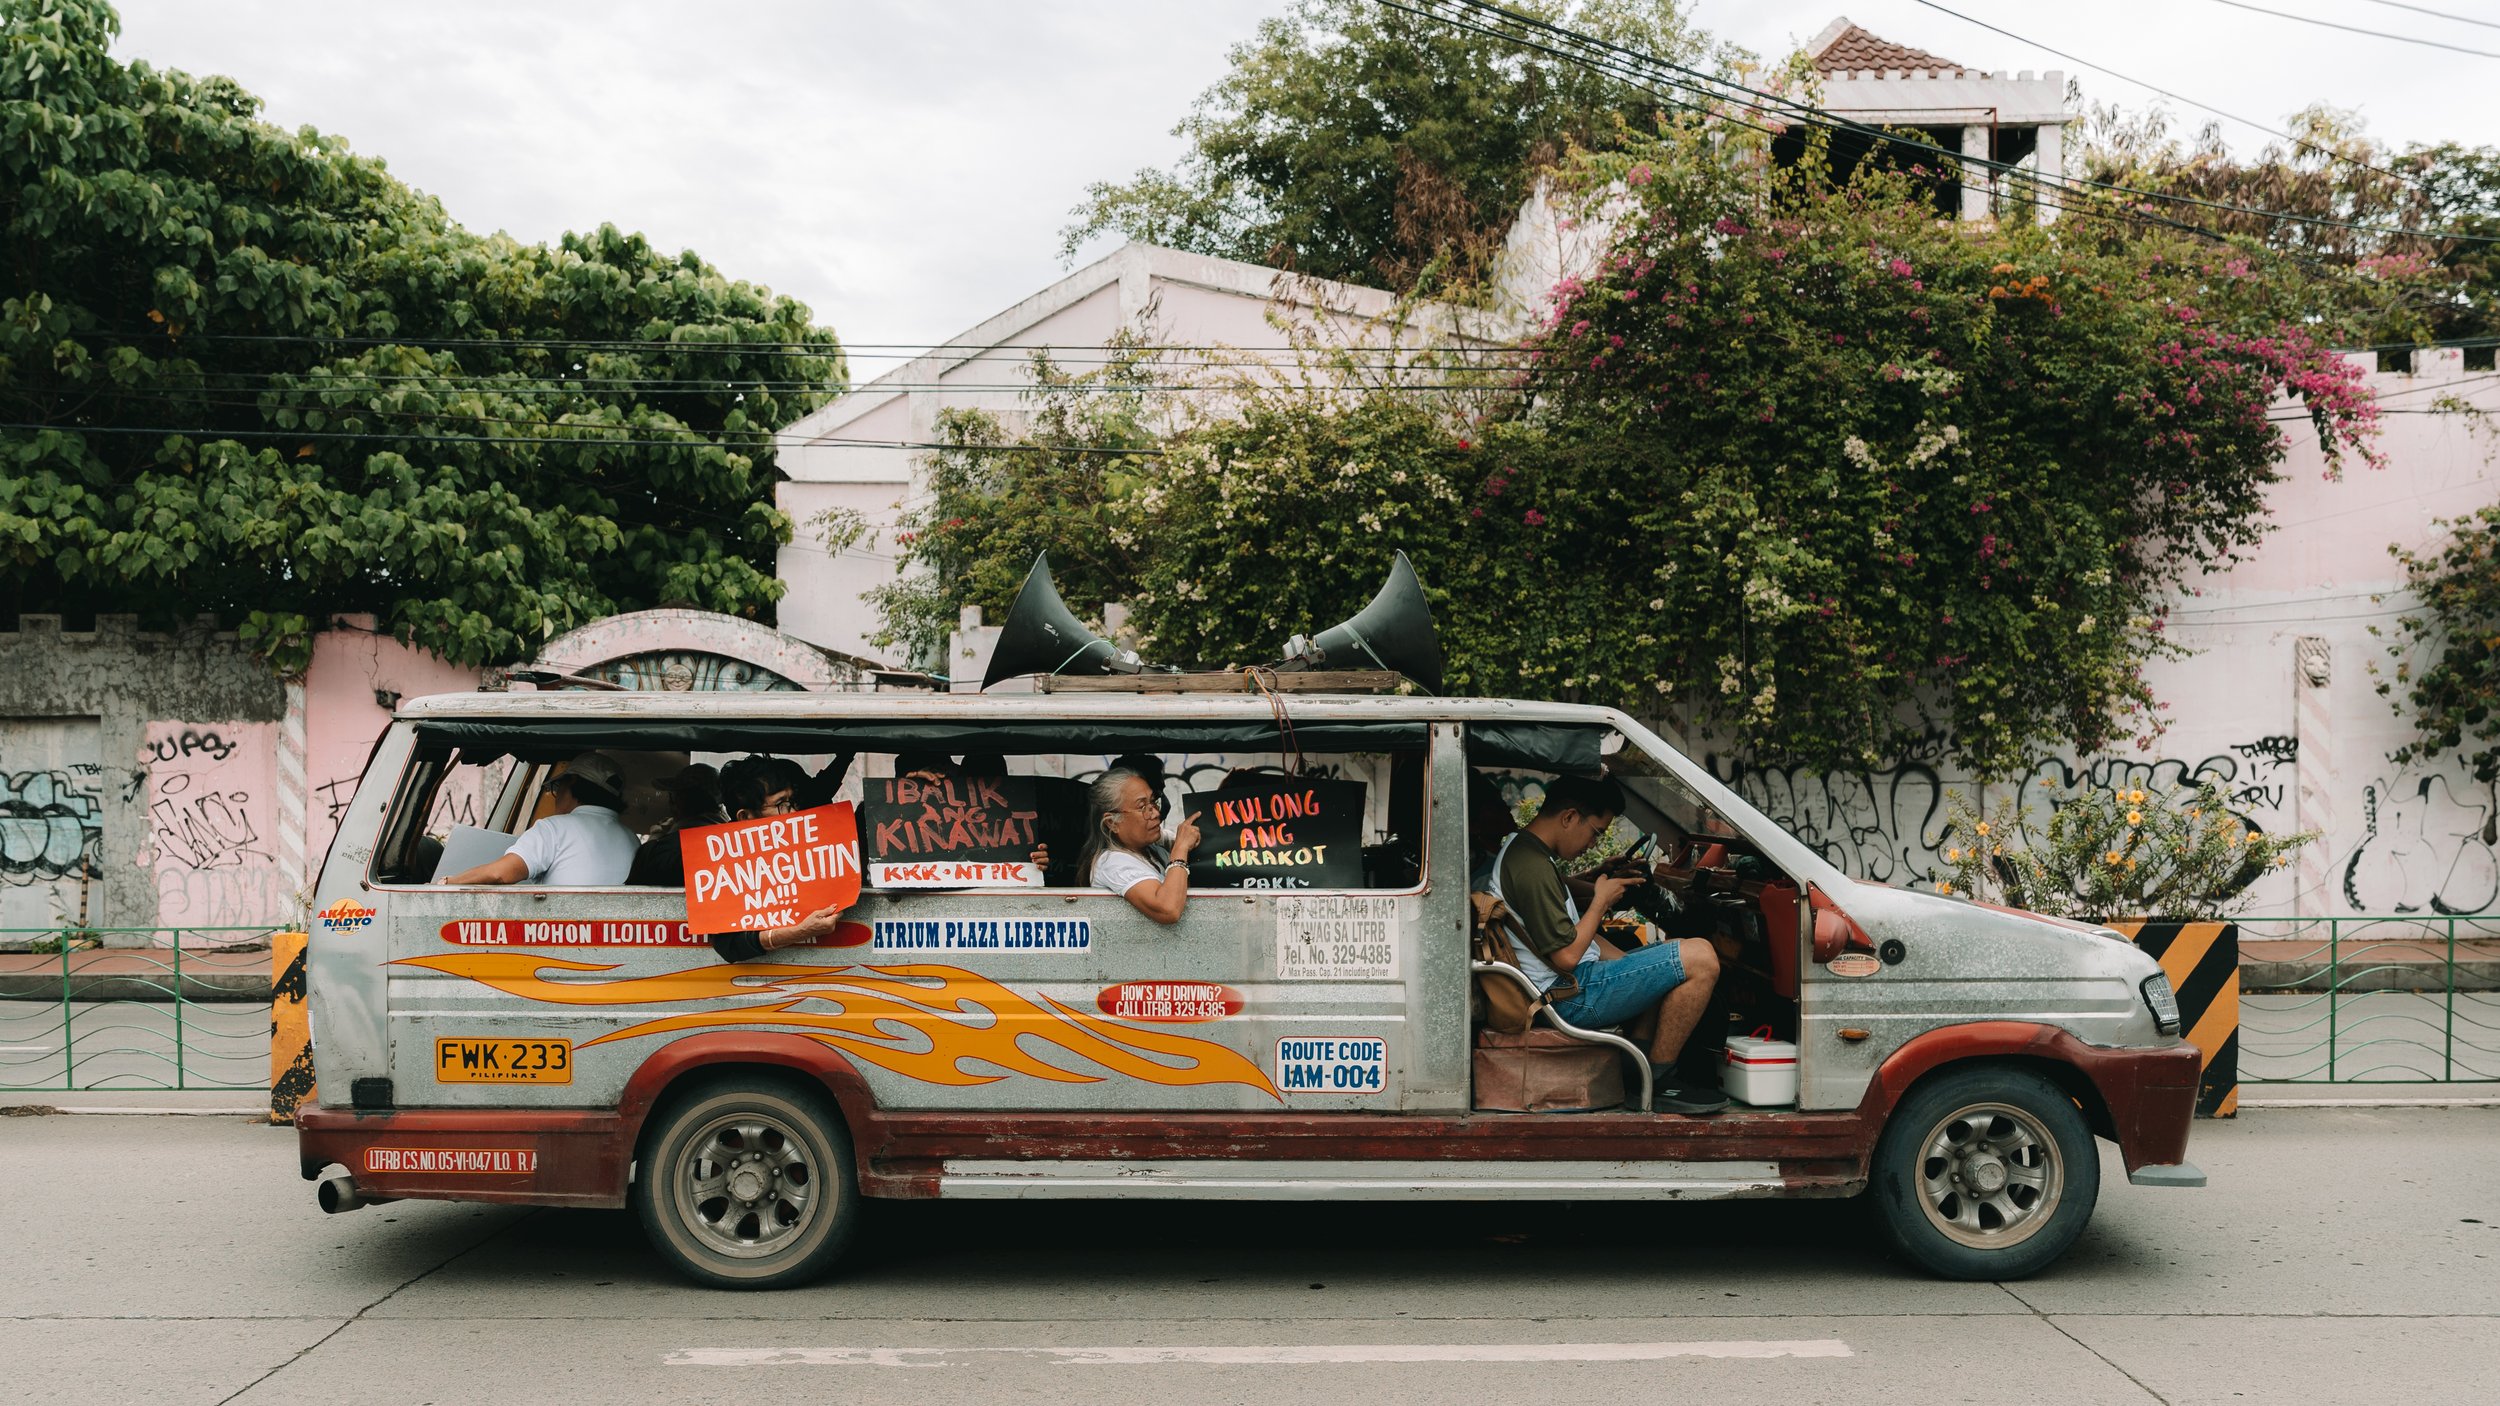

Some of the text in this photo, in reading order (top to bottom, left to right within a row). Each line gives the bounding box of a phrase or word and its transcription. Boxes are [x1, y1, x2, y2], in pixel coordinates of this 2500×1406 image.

[886, 777, 1008, 809] IBALIK
[1214, 790, 1320, 827] IKULONG
[706, 814, 818, 862] DUTERTE
[876, 811, 1038, 857] KINAWAT
[1240, 822, 1294, 848] ANG
[1216, 845, 1327, 869] KURAKOT
[694, 840, 861, 902] PANAGUTIN
[744, 883, 799, 911] NA!!!
[1373, 898, 1395, 919] KA?
[324, 917, 372, 927] RADYO
[458, 922, 508, 944] VILLA
[524, 922, 591, 943] MOHON
[603, 923, 667, 945] ILOILO
[1334, 921, 1348, 942] SA
[1352, 921, 1386, 942] LTFRB
[874, 922, 1090, 948] ATRIUM PLAZA LIBERTAD
[1284, 945, 1392, 964] Tel. No. 329-4385
[1343, 967, 1370, 979] including
[1371, 967, 1389, 977] Driver
[1121, 985, 1153, 1001] HOW'S
[1173, 986, 1222, 1001] DRIVING?
[1116, 1001, 1226, 1016] CALL LTFRB 329-4385
[1281, 1042, 1382, 1061] ROUTE CODE
[369, 1150, 400, 1170] LTFRB
